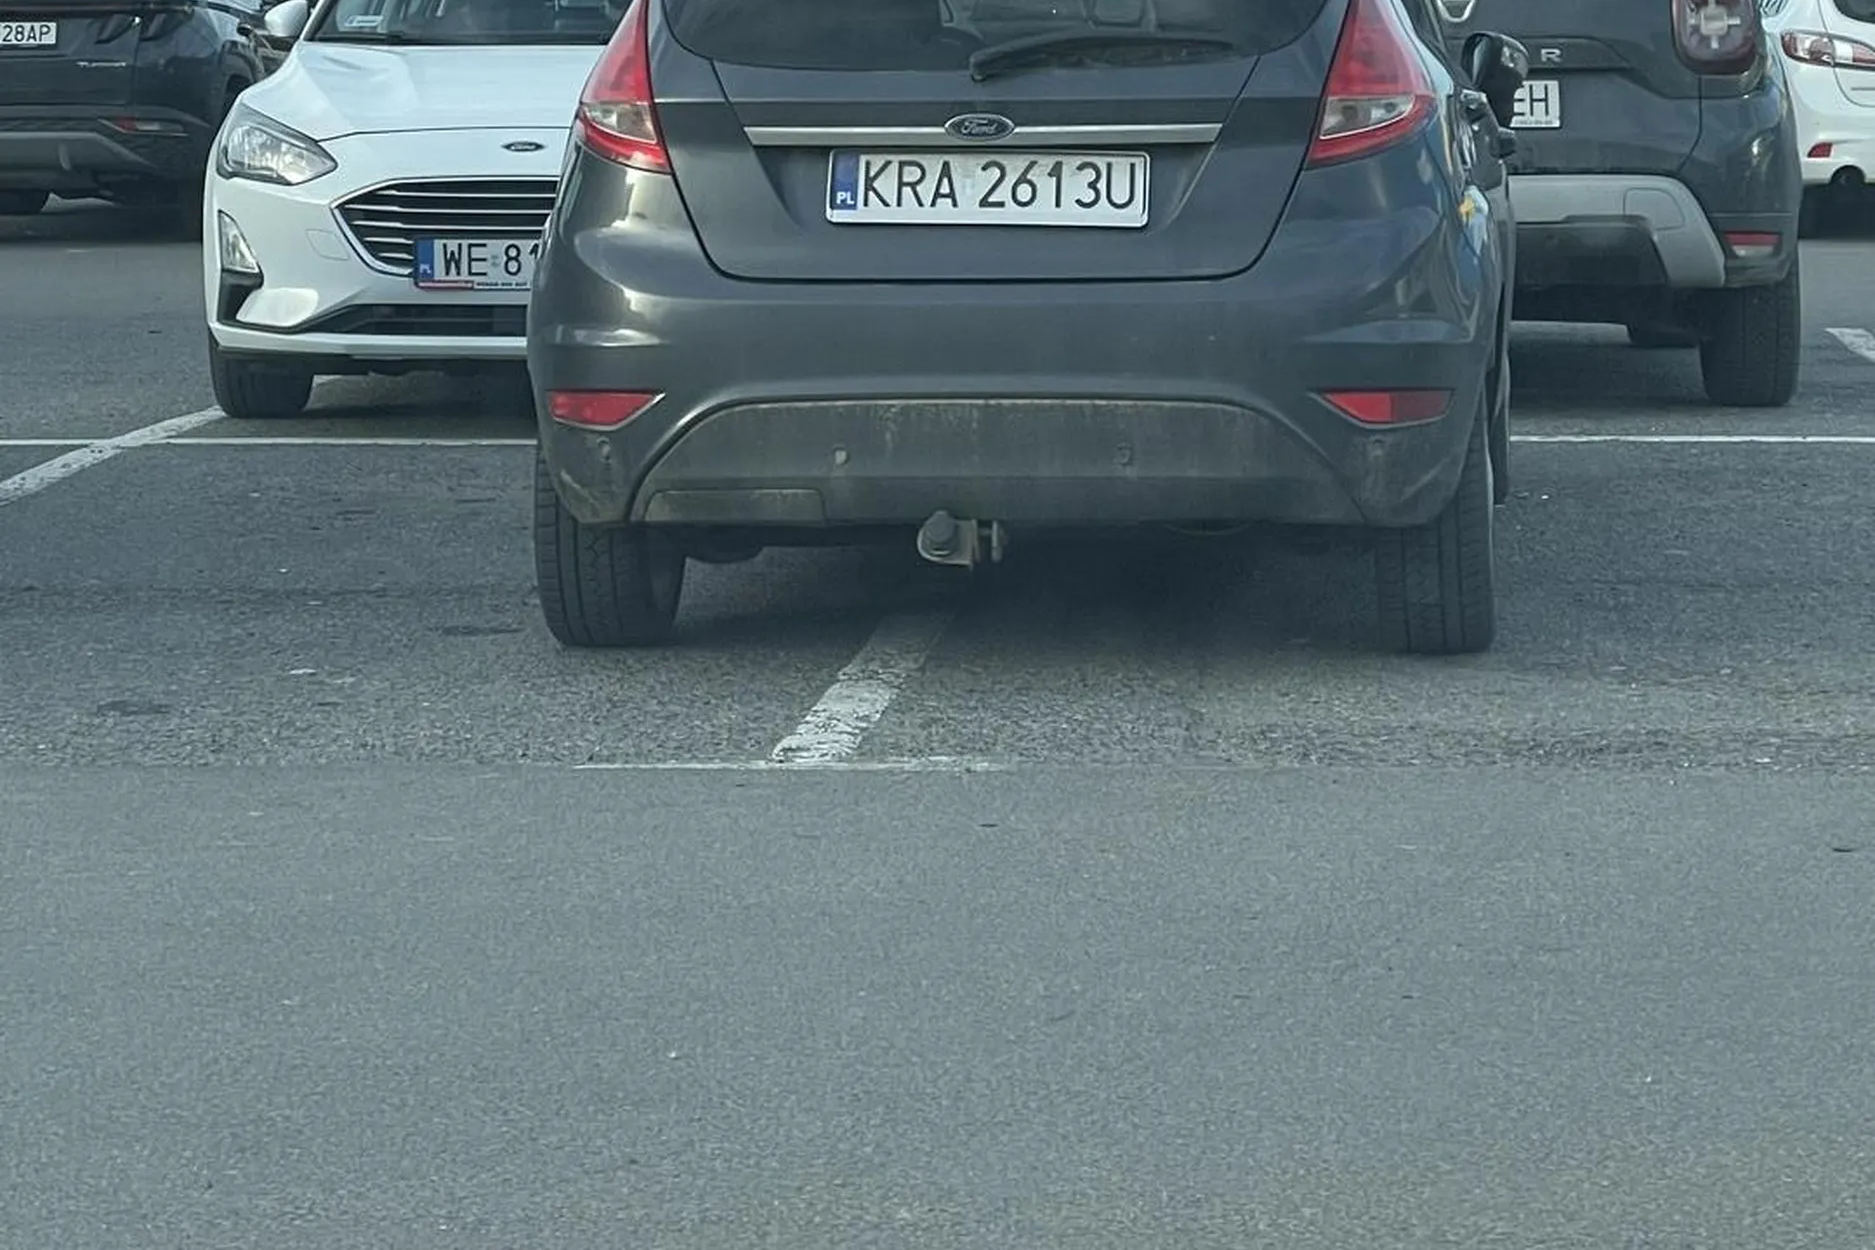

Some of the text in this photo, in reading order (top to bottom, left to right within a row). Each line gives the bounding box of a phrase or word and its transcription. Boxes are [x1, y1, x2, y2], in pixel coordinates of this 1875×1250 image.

[2, 24, 51, 43] 28AP
[862, 160, 1137, 210] KRA 2613U
[836, 192, 855, 205] PL
[442, 242, 487, 276] WE
